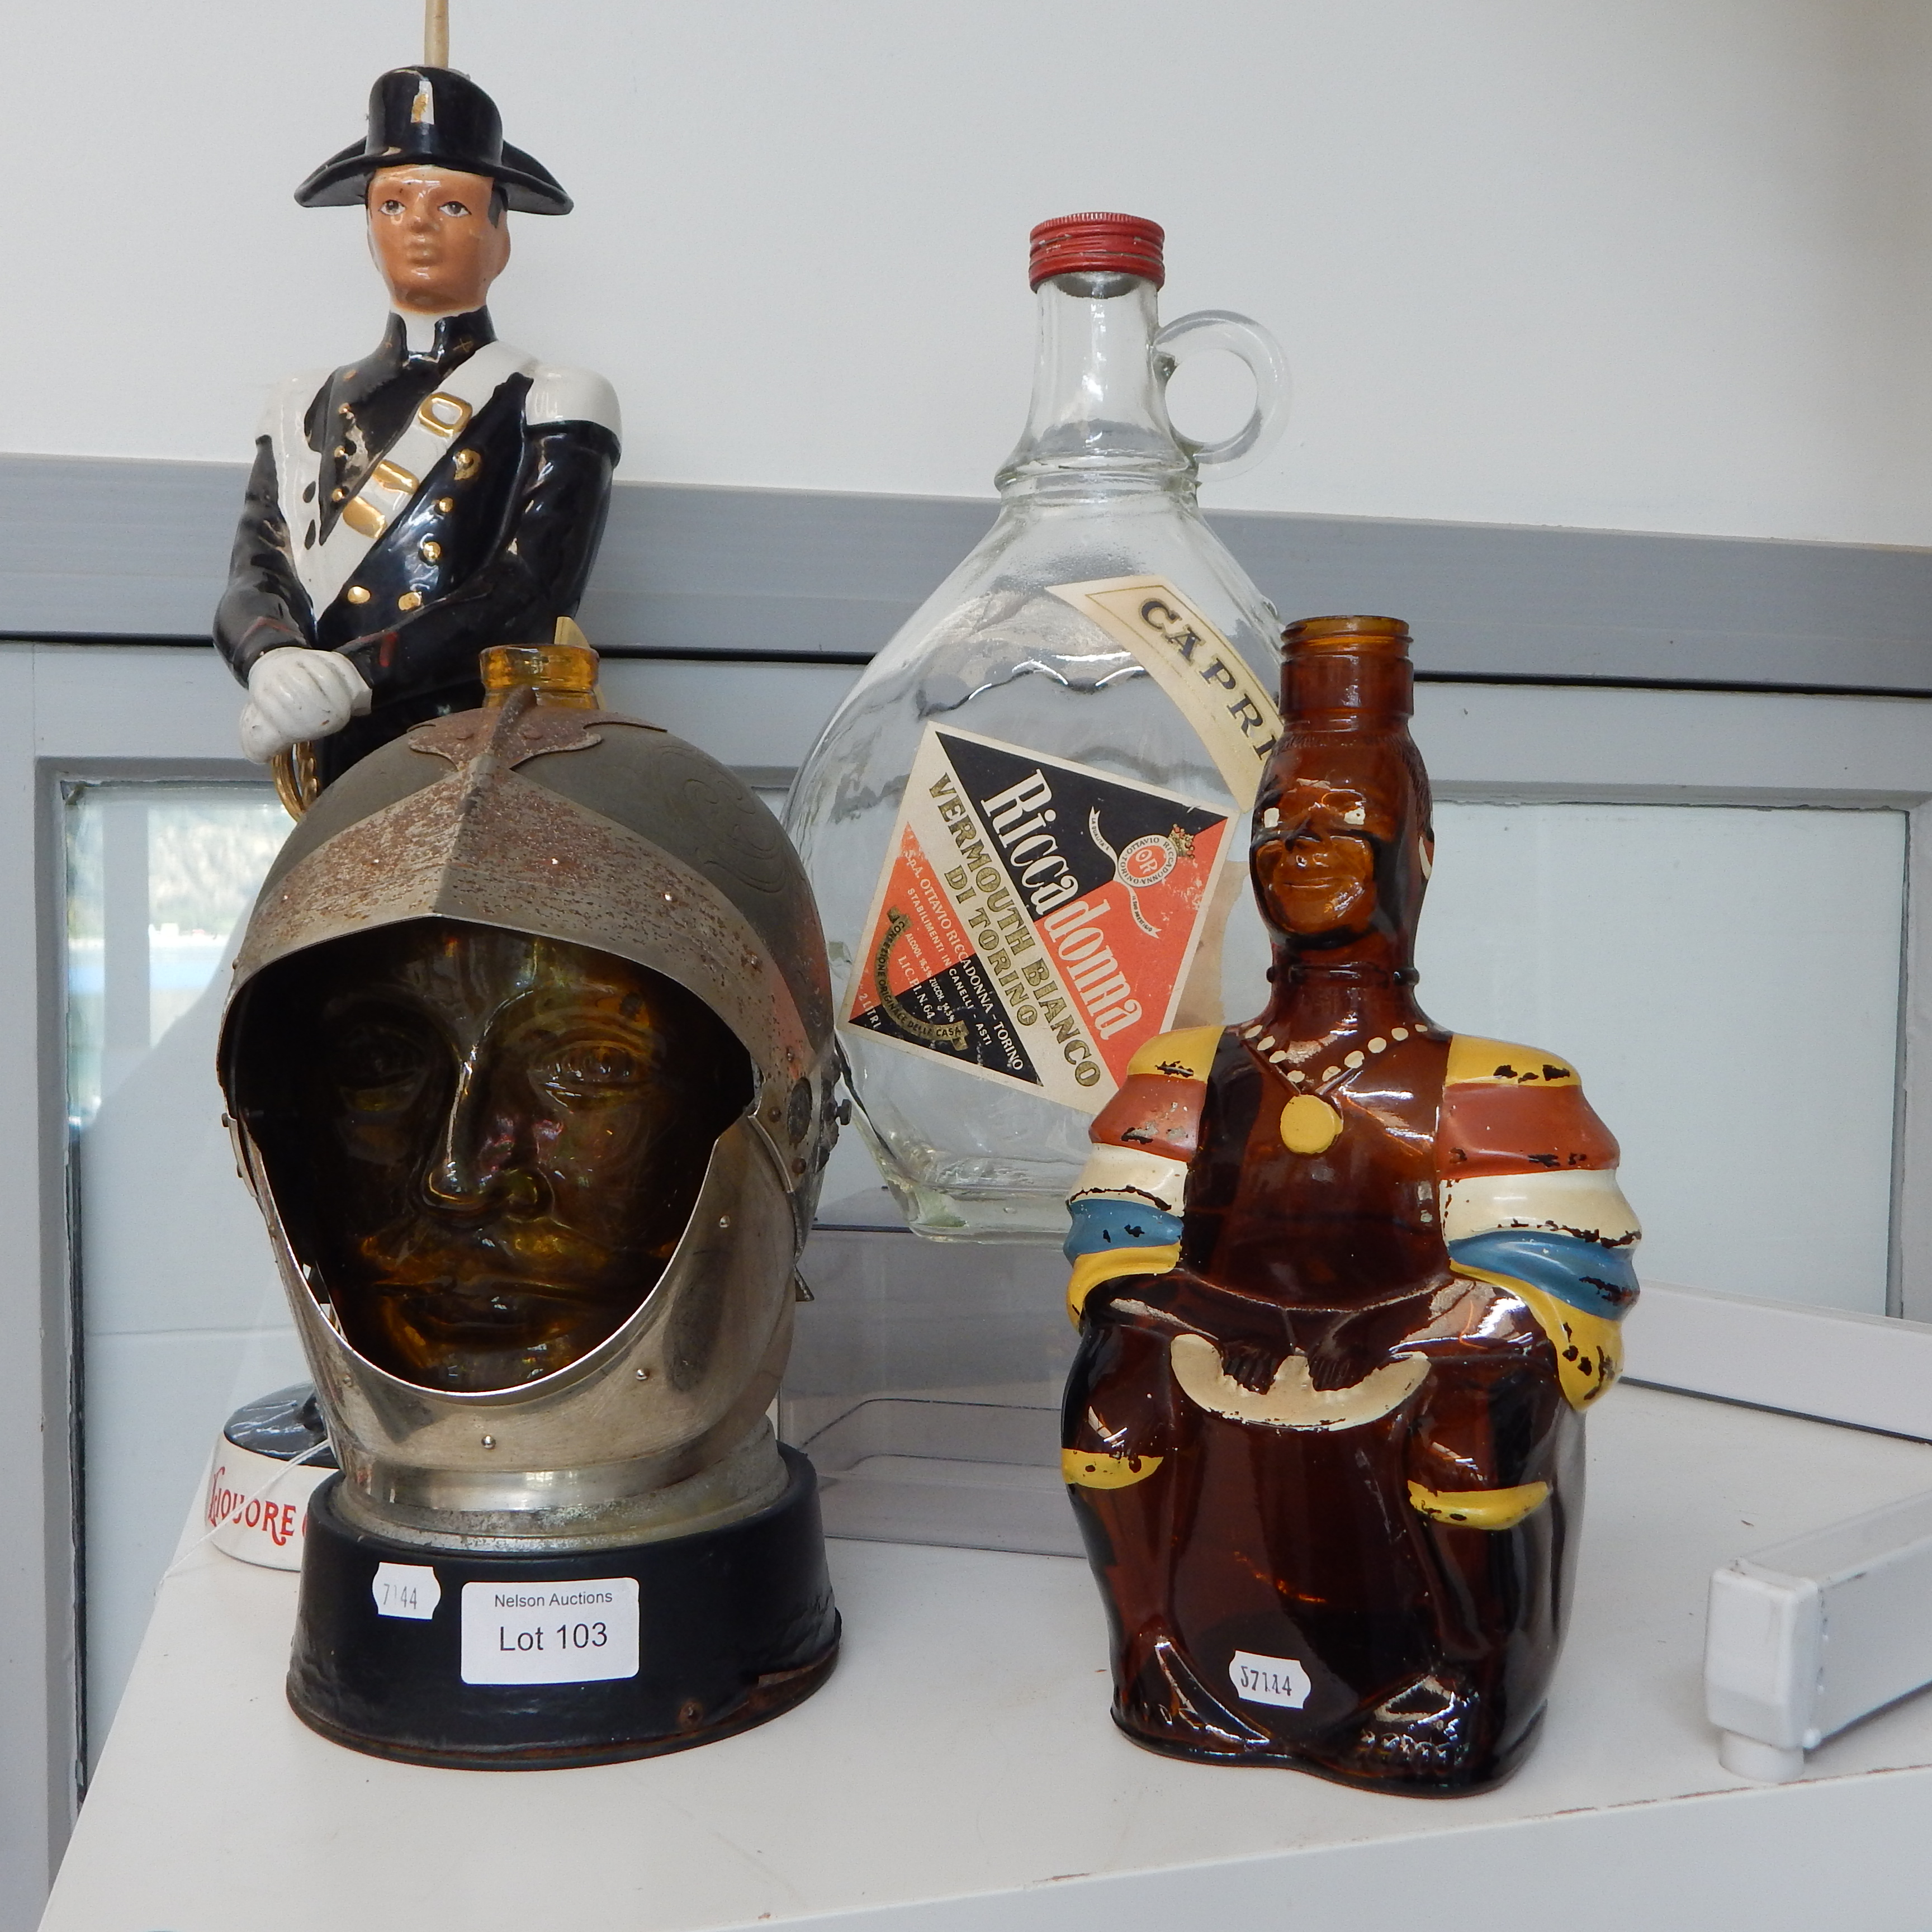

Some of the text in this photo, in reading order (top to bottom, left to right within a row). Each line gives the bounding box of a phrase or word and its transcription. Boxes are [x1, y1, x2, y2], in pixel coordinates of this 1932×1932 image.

[1139, 598, 1278, 761] CAPRI
[1126, 837, 1160, 854] OTTAVIO
[1135, 849, 1158, 874] OR
[929, 772, 1101, 1087] VERMOUTH BIANCO
[944, 864, 1038, 1026] DI TORINO
[981, 768, 1143, 1040] Riccadonna
[858, 993, 882, 1028] 2 LITRI
[878, 921, 905, 977] CONFEZIONE
[936, 1026, 962, 1037] CASA
[905, 933, 922, 958] ALCOOL
[929, 977, 945, 1002] ZUCCH.
[907, 887, 945, 952] STABILIMENTI
[941, 954, 953, 967] IN
[949, 968, 974, 1010] CANELLI
[976, 1022, 992, 1045] ASTI
[920, 878, 952, 929] OTTAVIO
[946, 929, 994, 1014] RICCADONNA
[993, 1021, 1024, 1071] TORINO
[495, 1590, 613, 1608] Nelson Auctions
[499, 1622, 608, 1652] Lot 103
